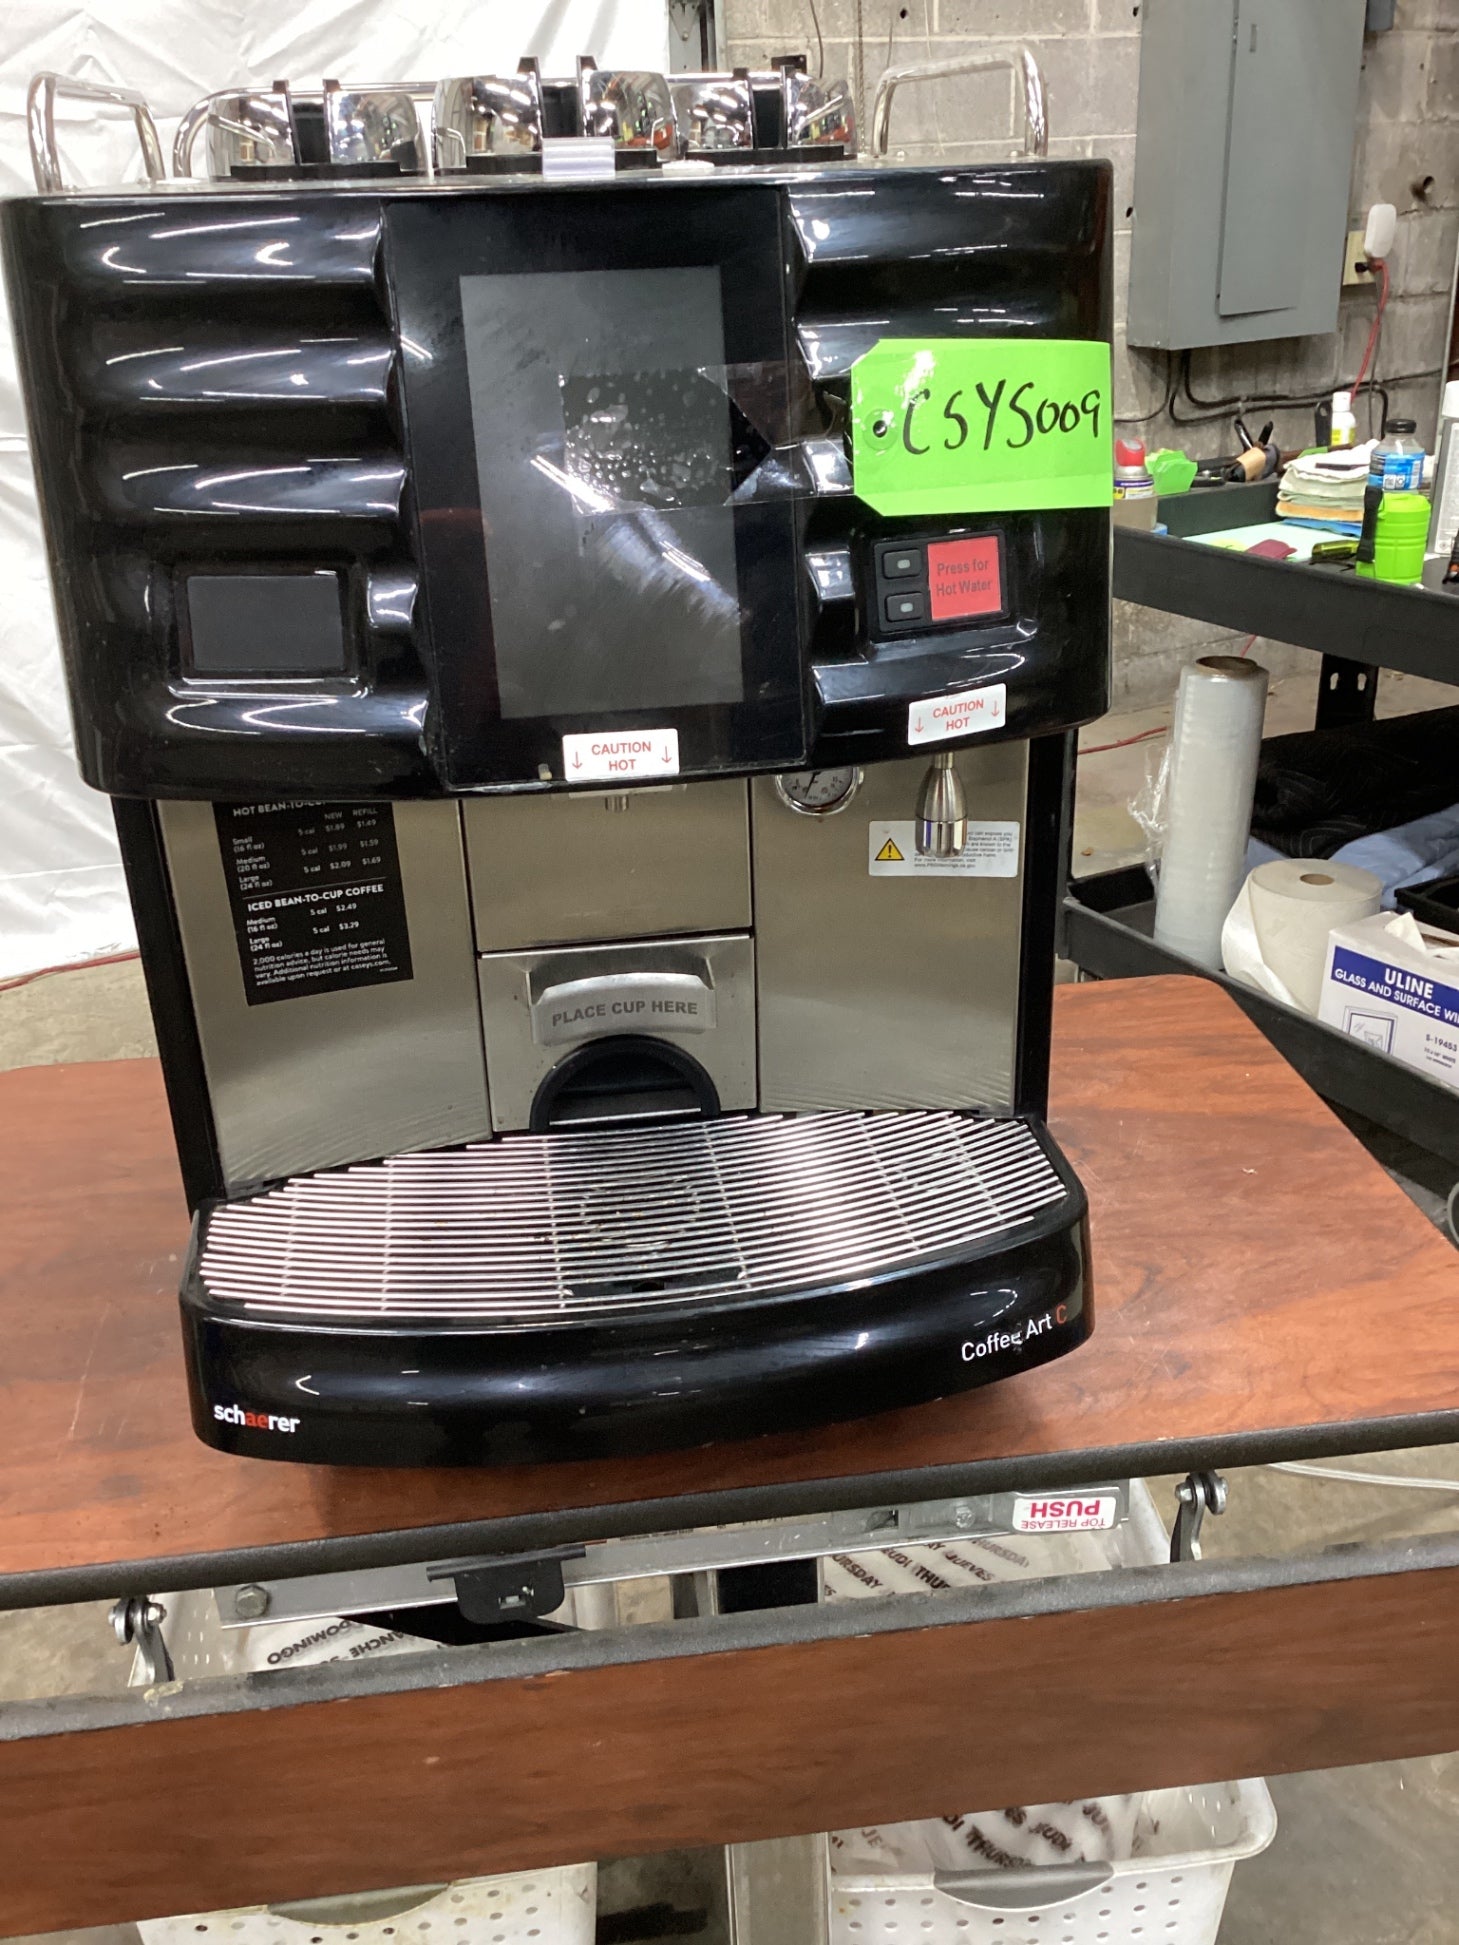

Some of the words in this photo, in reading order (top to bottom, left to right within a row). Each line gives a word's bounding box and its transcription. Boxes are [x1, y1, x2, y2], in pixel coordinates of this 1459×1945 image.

[936, 561, 970, 576] Press
[972, 558, 989, 571] for
[936, 583, 957, 597] Hot
[959, 579, 992, 595] Water
[932, 699, 984, 718] CAUTION
[946, 717, 970, 731] HOT
[591, 741, 652, 755] CAUTION
[608, 759, 637, 771] HOT
[233, 806, 255, 816] HOT
[236, 856, 266, 865] Medium
[239, 875, 259, 884] Large
[248, 901, 273, 912] ICED
[274, 890, 343, 908] BEAN-TO-CUP
[345, 884, 384, 897] COFFEE
[317, 907, 328, 915] cal
[246, 917, 276, 926] Medium
[319, 925, 330, 933] cal
[249, 937, 270, 945] Large
[276, 952, 304, 961] calories
[360, 938, 385, 949] general
[254, 962, 285, 971] nutrition
[324, 951, 348, 960] calorie
[348, 948, 369, 956] needs
[370, 947, 385, 955] may
[273, 964, 309, 975] Additional
[309, 960, 341, 969] nutrition
[341, 953, 381, 964] information
[256, 976, 286, 986] available
[287, 973, 306, 982] upon
[306, 968, 333, 978] request
[1384, 968, 1434, 999] ULINE
[1334, 968, 1367, 988] GLASS
[1368, 981, 1392, 997] AND
[1393, 990, 1442, 1016] SURFACE
[1444, 1008, 1459, 1024] WI
[552, 1003, 607, 1027] PLACE
[611, 1000, 646, 1014] CUP
[652, 1000, 698, 1015] HERE
[961, 1332, 1023, 1361] Coffee
[1026, 1313, 1053, 1340] Art
[1056, 1304, 1068, 1324] C
[213, 1404, 301, 1433] schaerer
[1030, 1500, 1101, 1518] PUSH
[1020, 1519, 1077, 1530] RELEASE
[1081, 1518, 1105, 1528] TOP
[267, 1619, 353, 1665] DOMINGO
